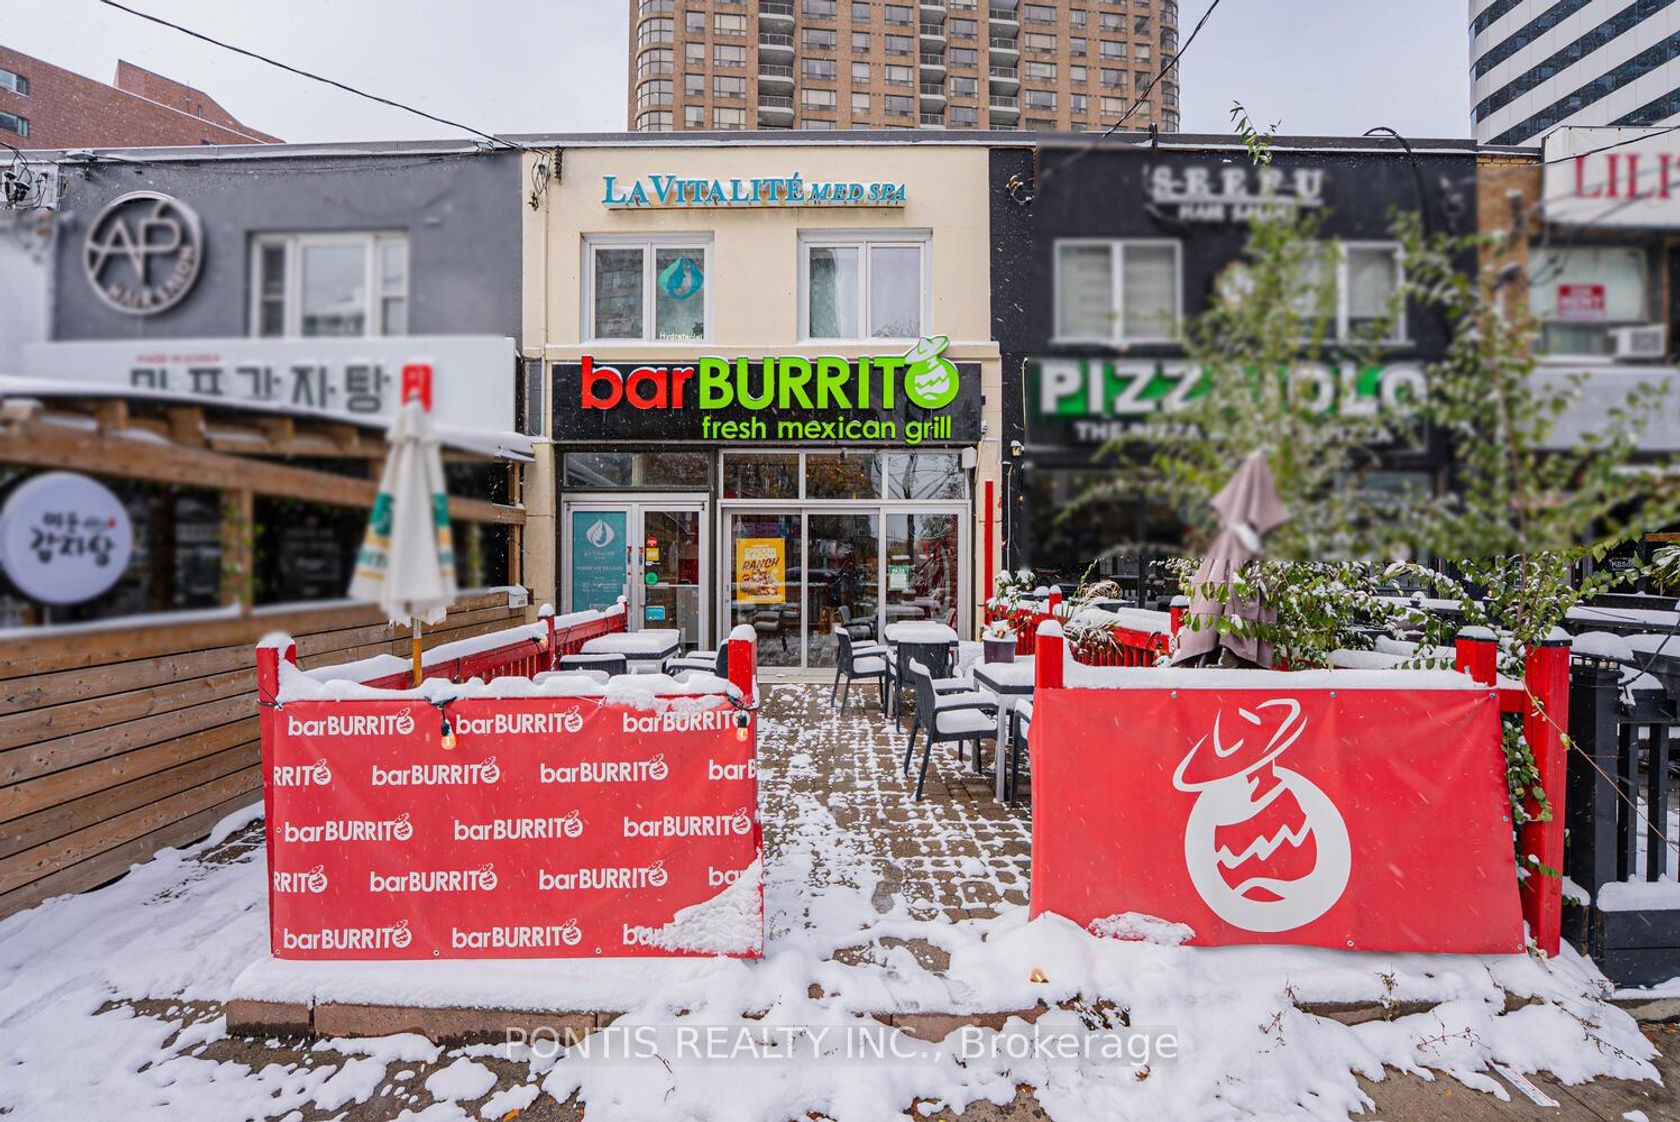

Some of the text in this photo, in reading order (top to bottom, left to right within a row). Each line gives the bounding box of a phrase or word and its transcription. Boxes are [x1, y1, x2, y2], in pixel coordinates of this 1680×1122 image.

[808, 183, 865, 201] MED
[868, 183, 907, 201] SPA
[702, 416, 952, 445] fresh mexican grill
[742, 557, 780, 570] RANCH
[288, 708, 415, 736] barBURRITO
[456, 706, 583, 735] barBURRITO
[372, 756, 500, 786] barBURRITO
[540, 753, 668, 783] barBURRITO
[284, 813, 413, 842] barBURRITO
[454, 810, 583, 840] barBURRITO
[624, 807, 751, 837] barBURRITO
[370, 863, 498, 893] barBURRITO
[539, 860, 668, 890] barBURRITO
[284, 919, 412, 950] barBURRITO
[452, 918, 582, 948] barBURRITO
